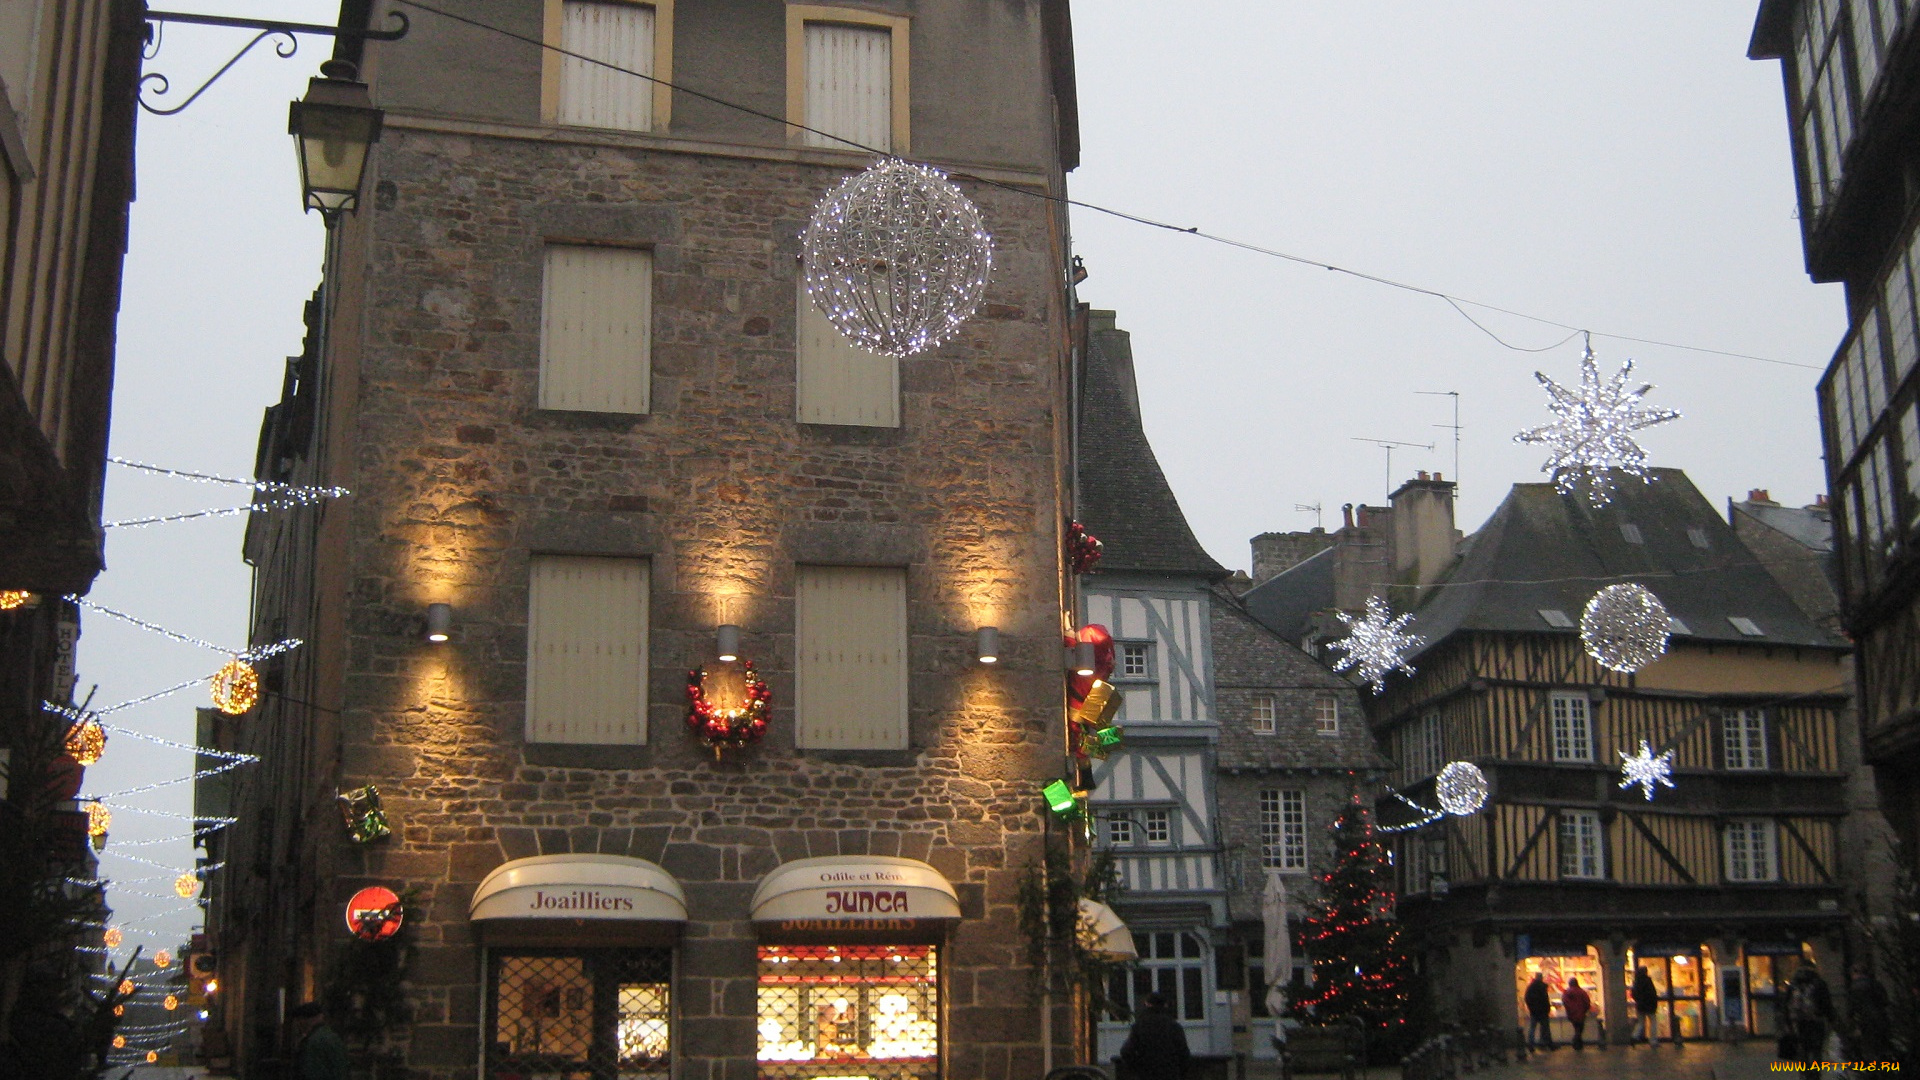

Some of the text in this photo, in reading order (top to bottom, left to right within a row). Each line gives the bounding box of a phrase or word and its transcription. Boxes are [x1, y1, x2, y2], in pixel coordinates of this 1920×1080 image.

[859, 872, 871, 881] et
[529, 890, 634, 911] Joailliers
[825, 890, 909, 914] JUNCA
